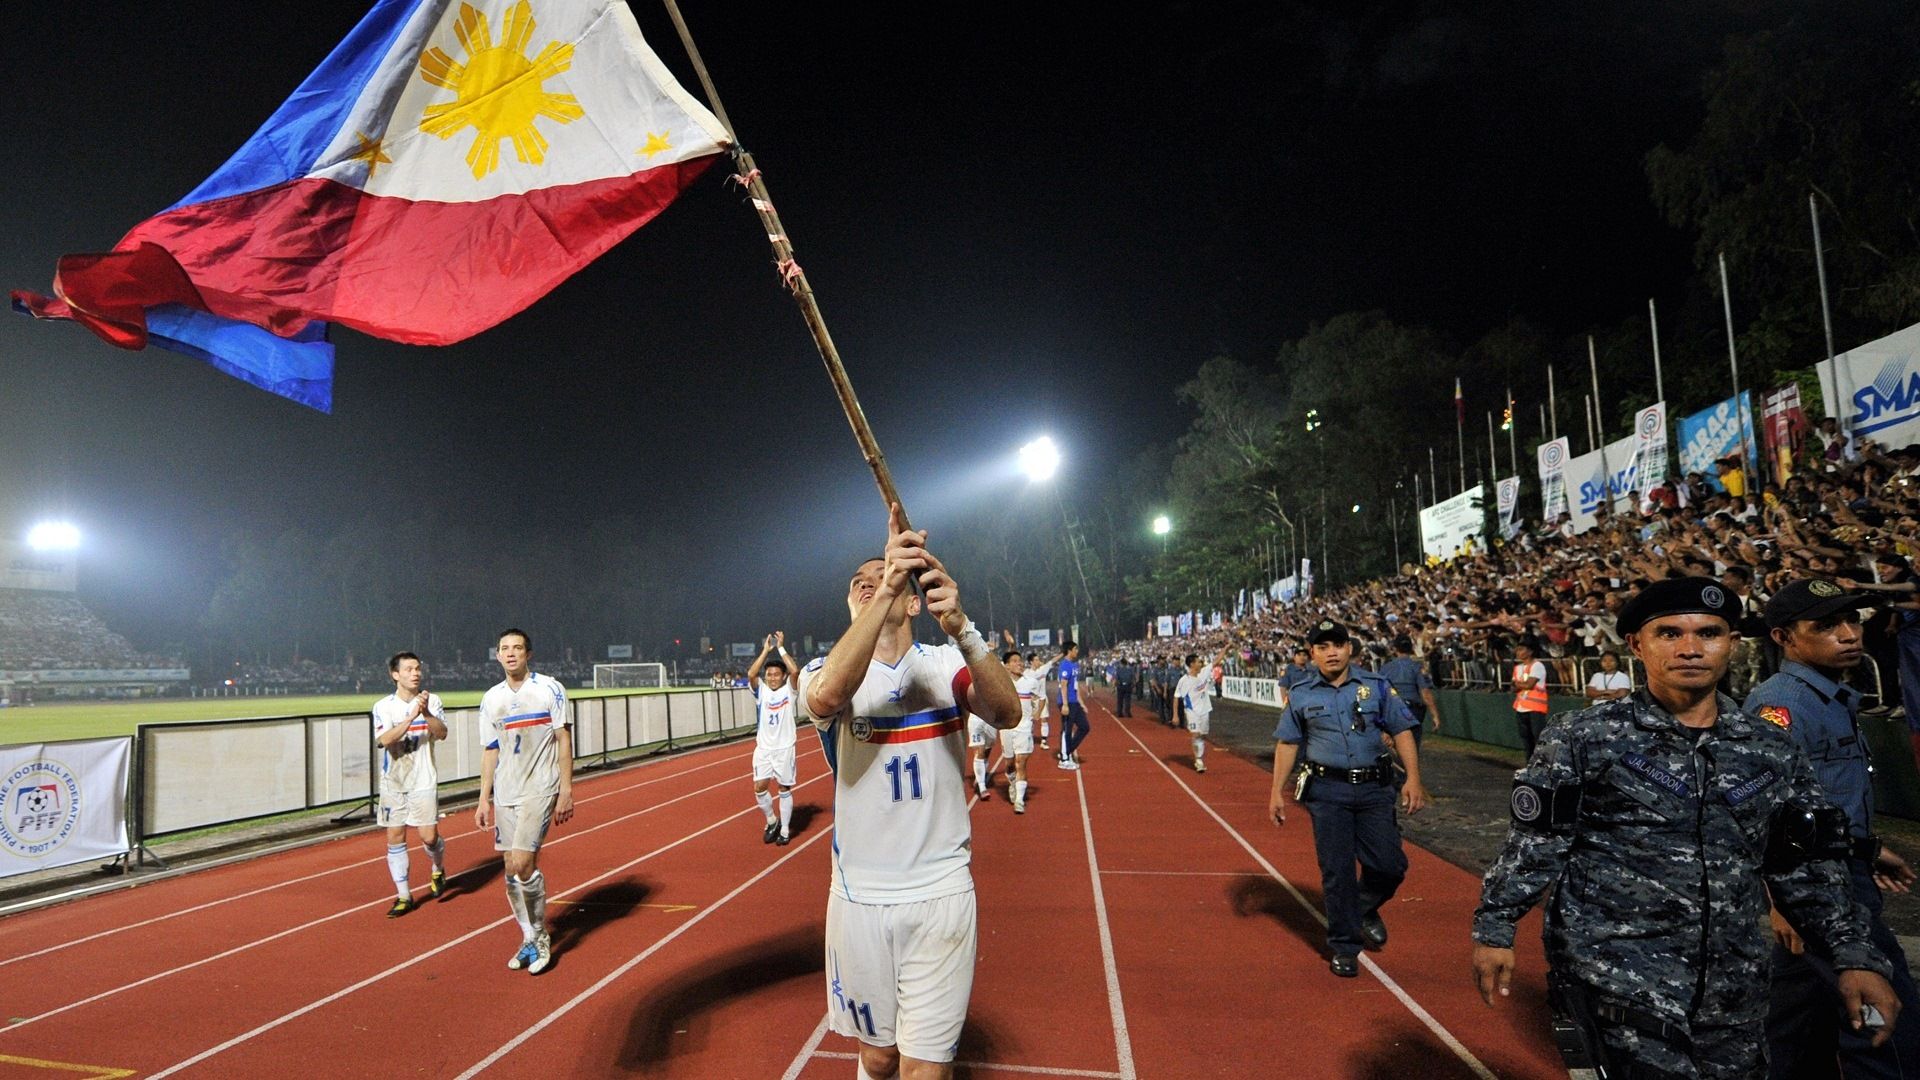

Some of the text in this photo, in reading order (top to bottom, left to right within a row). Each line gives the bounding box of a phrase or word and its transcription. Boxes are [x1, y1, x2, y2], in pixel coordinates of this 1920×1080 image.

[1679, 402, 1729, 470] SARAP
[1226, 679, 1276, 702] PANA-AD PARK
[769, 713, 779, 725] 21
[513, 734, 521, 754] 2
[885, 753, 922, 802] 11
[8, 763, 61, 785] FOOTBALL
[60, 773, 79, 839] FEDERATION
[18, 811, 62, 833] PFF
[28, 842, 49, 854] 1907
[847, 998, 877, 1038] 11
